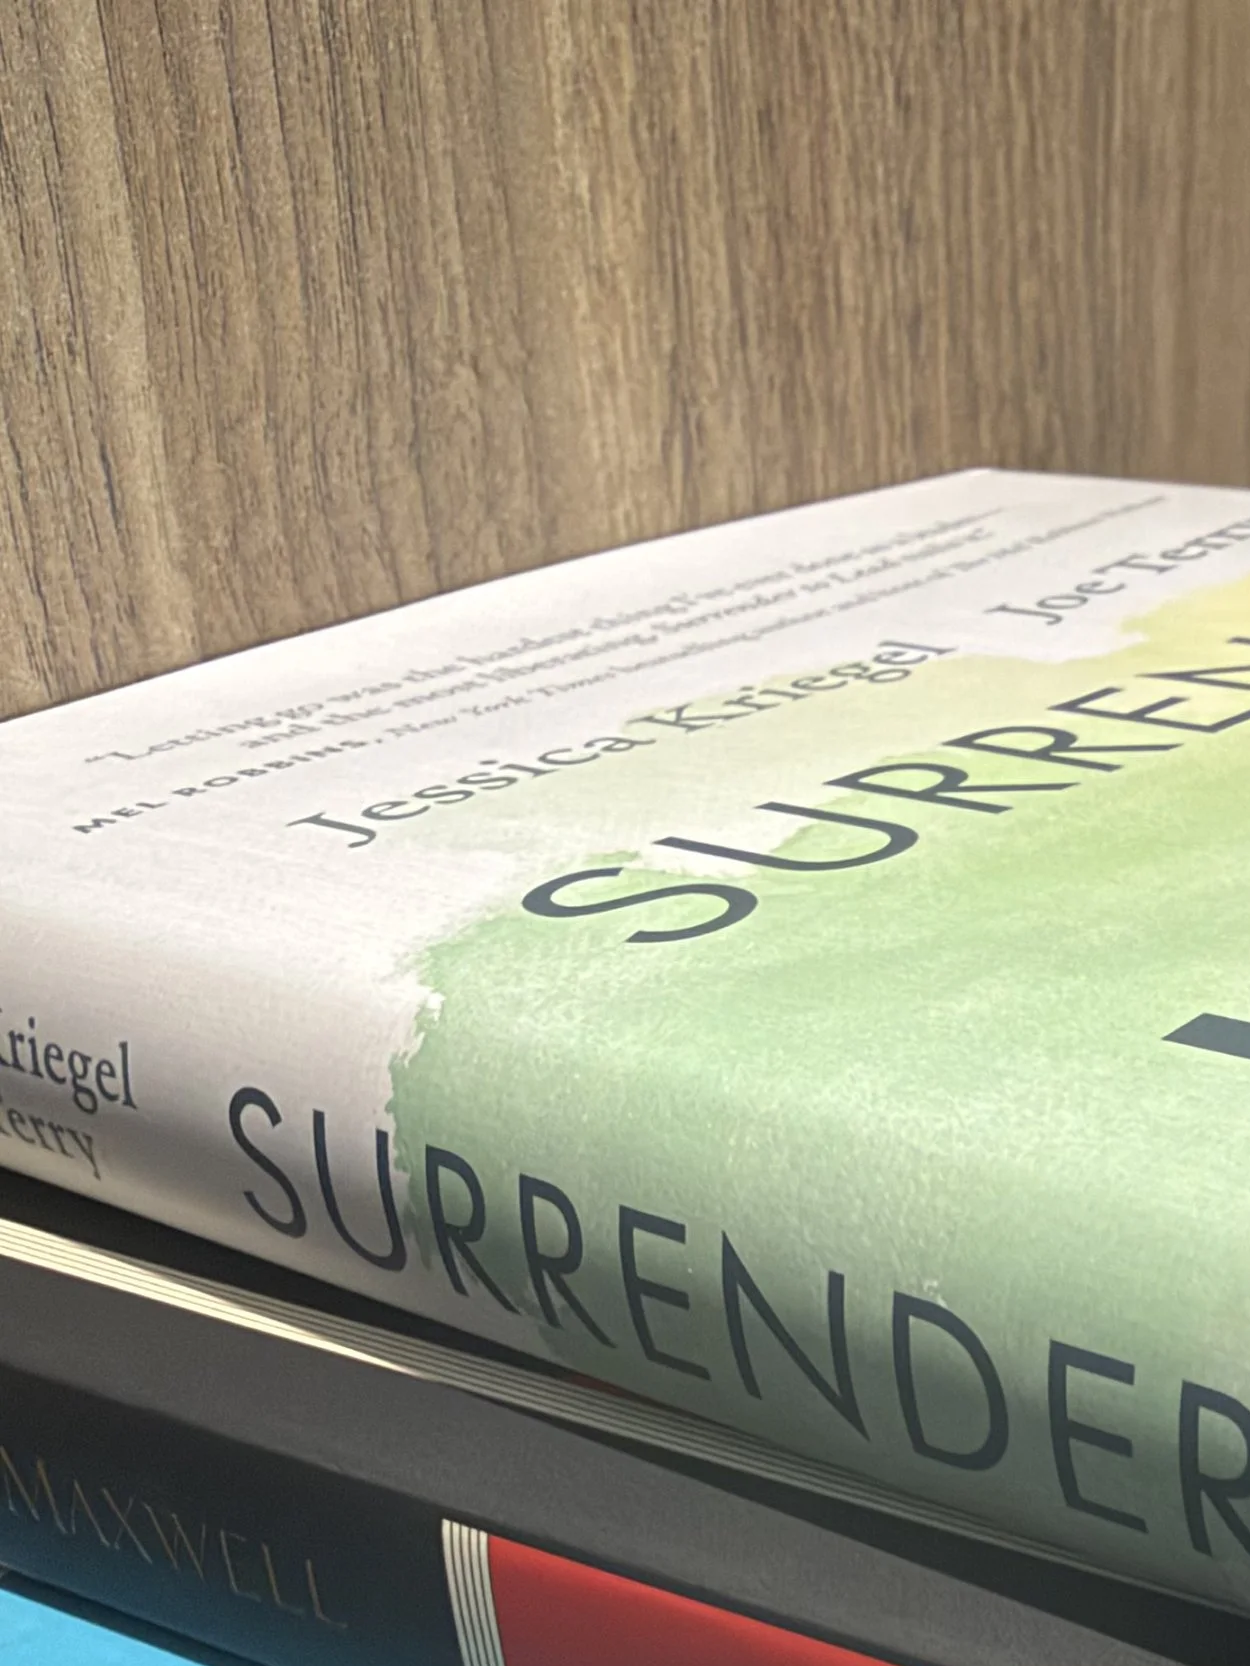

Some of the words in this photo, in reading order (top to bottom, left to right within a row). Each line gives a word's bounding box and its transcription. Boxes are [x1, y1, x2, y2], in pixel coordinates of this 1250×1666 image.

[983, 580, 1128, 626] Joe
[240, 723, 322, 749] and
[319, 705, 393, 727] the
[392, 680, 489, 708] most
[326, 681, 402, 701] was
[402, 662, 466, 683] the
[285, 736, 656, 849] Jessica
[625, 639, 957, 734] Kriegel
[72, 799, 169, 834] MEL
[172, 736, 384, 797] ROBBINS,
[0, 1013, 137, 1115] riegel
[0, 1102, 101, 1180] erry
